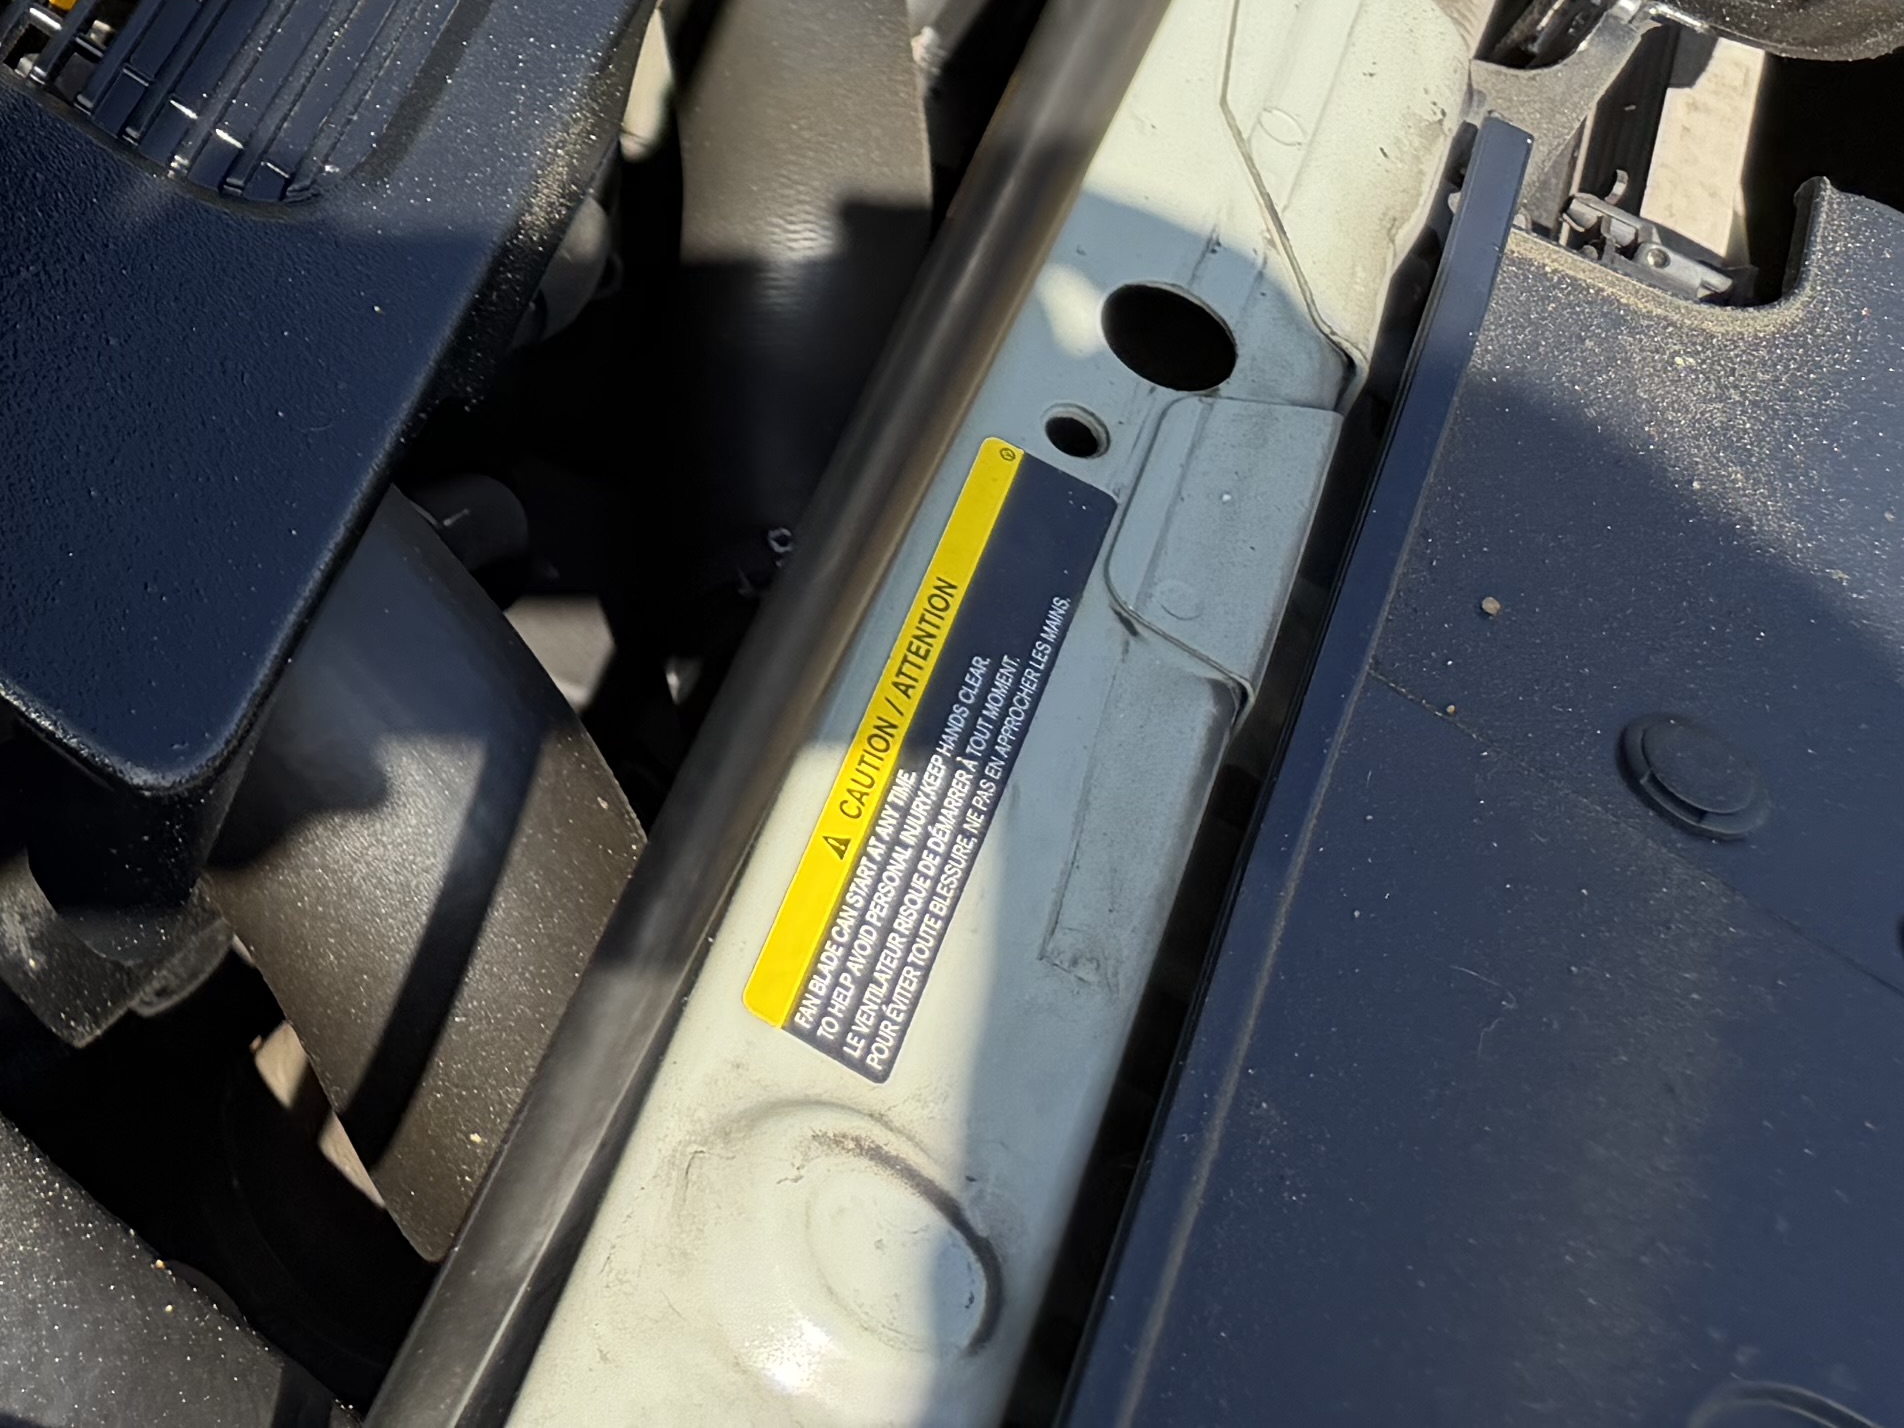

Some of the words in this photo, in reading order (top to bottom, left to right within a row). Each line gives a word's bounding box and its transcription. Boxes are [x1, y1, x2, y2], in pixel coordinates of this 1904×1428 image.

[1029, 640, 1052, 672] LES
[840, 716, 898, 820] CAUTION
[892, 576, 958, 700] ATTENTION
[995, 665, 1041, 758] APPROCHER
[965, 719, 993, 761] TOUT
[890, 768, 918, 815] TIME.
[985, 756, 1006, 780] EN
[927, 769, 974, 853] DÉMARRER
[974, 778, 997, 811] PAS
[876, 800, 901, 838] ANY
[963, 807, 985, 834] NE
[817, 1016, 839, 1040] TO
[831, 972, 856, 1020] HELP
[846, 924, 878, 977] AVOID
[867, 841, 912, 928] PERSONAL
[936, 703, 970, 761] HANDS
[958, 655, 991, 705] CLEAR.
[869, 834, 887, 863] AT
[917, 848, 940, 881] DE
[845, 856, 878, 909] START
[893, 868, 927, 940] RISQUE
[832, 904, 858, 943] CAN
[908, 915, 940, 970] TOUTE
[809, 940, 843, 1000] BLADE
[851, 931, 903, 1034] VENTILATEUR
[794, 992, 821, 1029] FAN
[881, 966, 922, 1022] ÉVITER
[843, 1031, 863, 1060] LE
[865, 1019, 898, 1071] POUR
